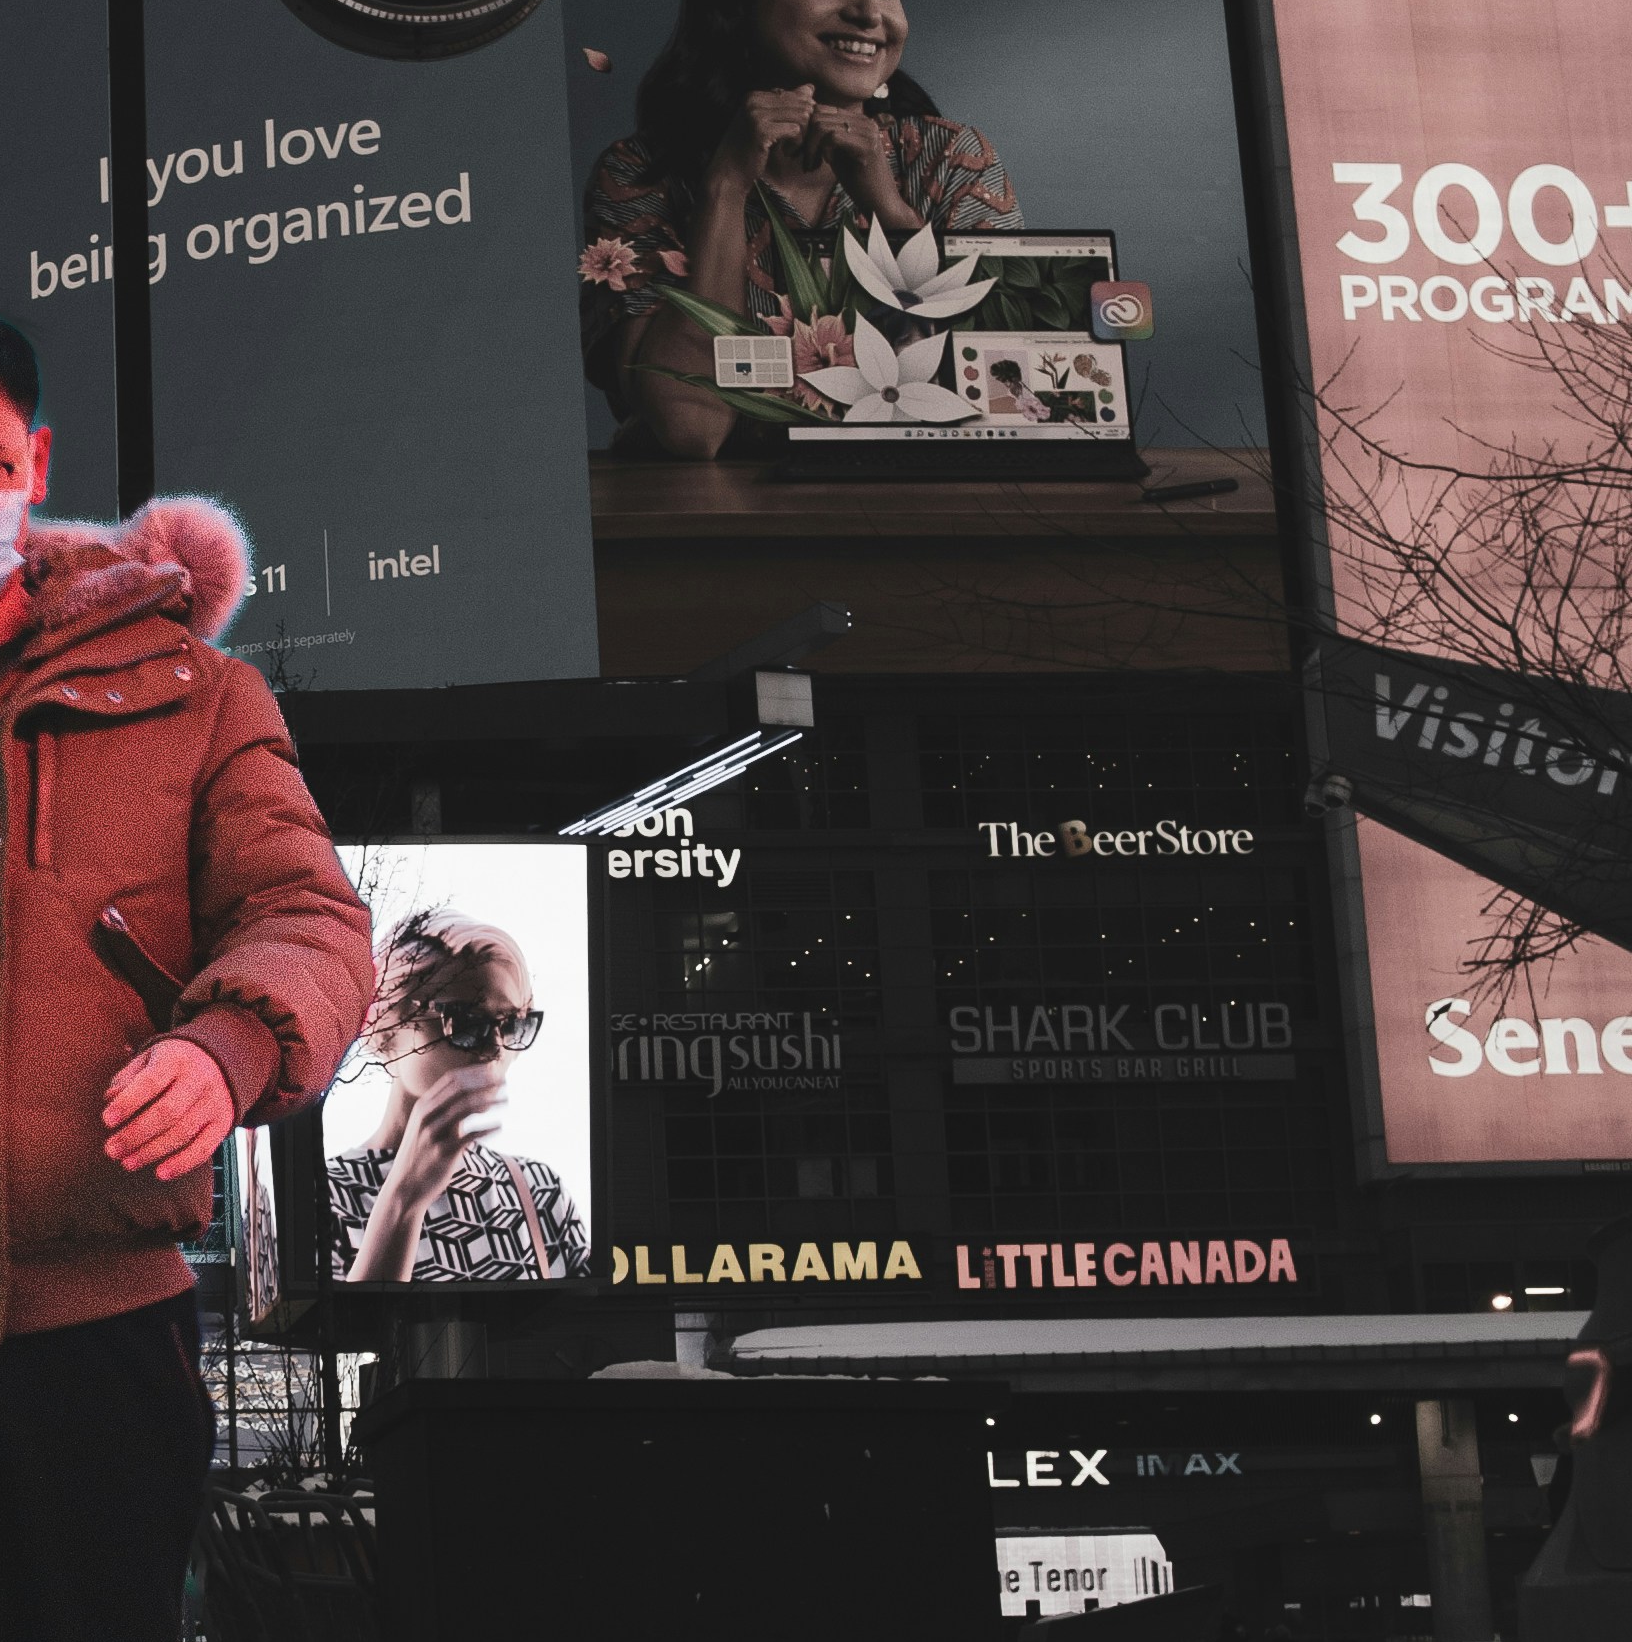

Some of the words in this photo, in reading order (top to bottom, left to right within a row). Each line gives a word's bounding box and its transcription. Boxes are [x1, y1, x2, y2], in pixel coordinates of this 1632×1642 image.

[145, 139, 245, 208] you
[264, 117, 382, 169] love
[185, 171, 472, 265] organized
[261, 563, 287, 594] 11
[368, 544, 441, 581] intel
[294, 628, 357, 649] separately
[978, 821, 1057, 857] The
[1058, 818, 1153, 857] Beer
[1156, 819, 1255, 856] Store
[608, 838, 741, 888] ersity
[652, 1012, 794, 1032] RESTAURANT
[948, 1004, 1136, 1053] SHARK
[1153, 1002, 1293, 1051] CLUB
[612, 1035, 723, 1099] ring
[729, 1012, 842, 1070] sushi
[1012, 1058, 1104, 1081] SPORTS
[1118, 1058, 1164, 1079] BAR
[1176, 1057, 1243, 1079] GRILL
[726, 1076, 752, 1091] ALL
[751, 1076, 784, 1090] YOU
[784, 1076, 815, 1090] CAN
[816, 1076, 841, 1090] EAT
[1104, 1238, 1298, 1286] CANADA
[987, 1449, 1111, 1488] LEX
[1028, 1561, 1108, 1593] Tenor
